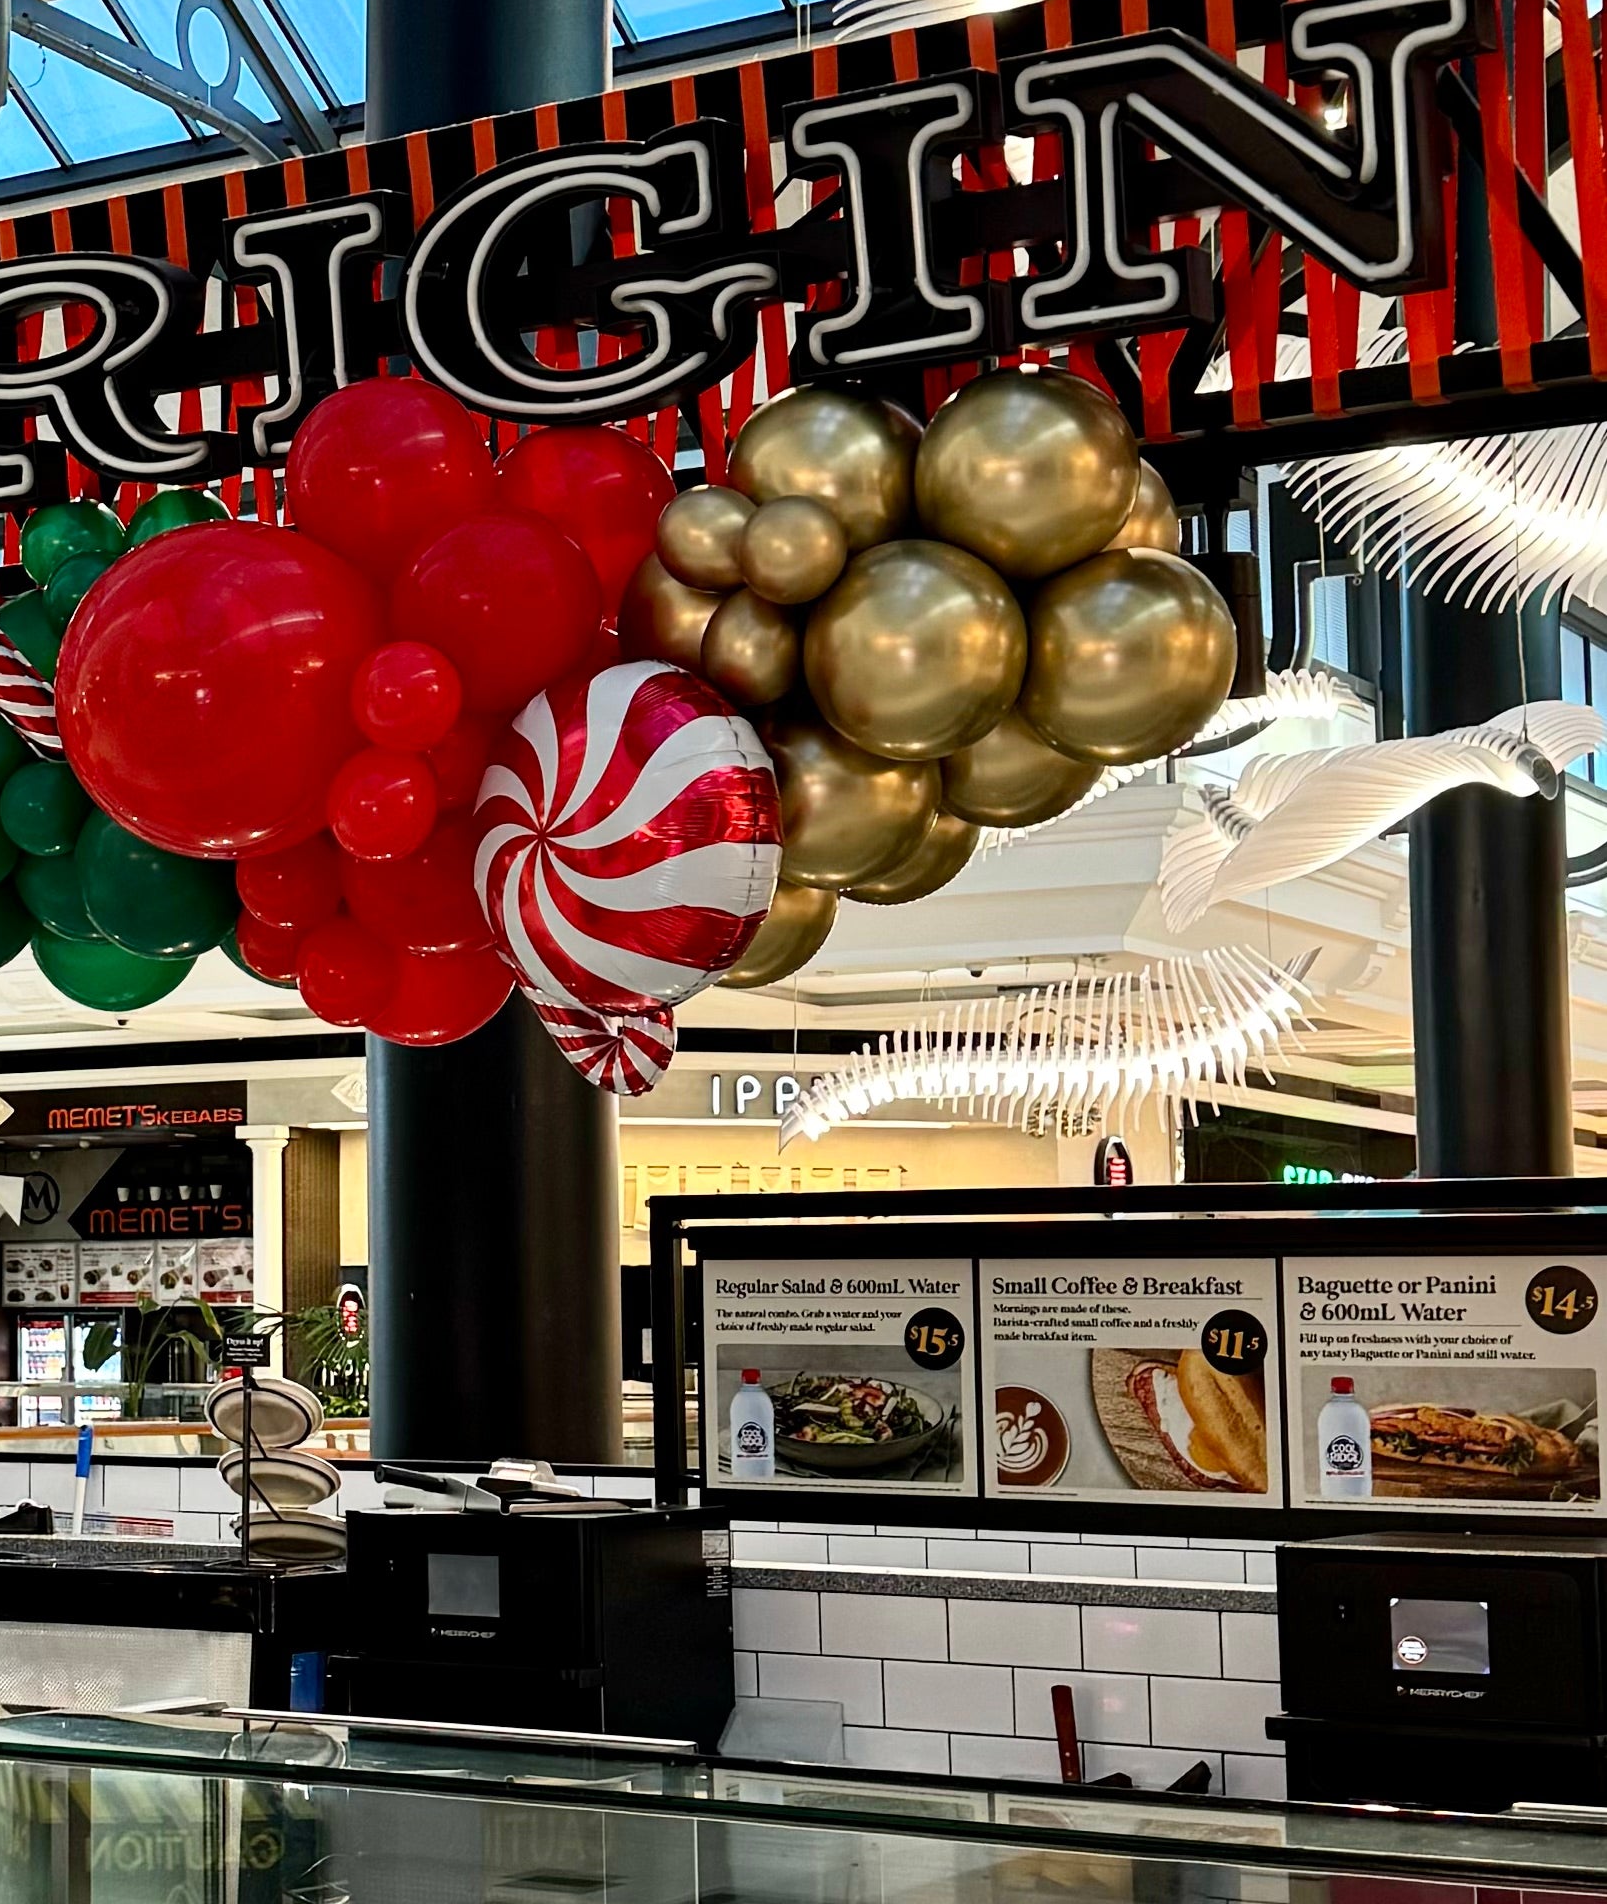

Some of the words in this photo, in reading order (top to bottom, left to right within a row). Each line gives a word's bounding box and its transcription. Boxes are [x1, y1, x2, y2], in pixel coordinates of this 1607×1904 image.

[712, 1074, 822, 1115] IPP
[48, 1104, 156, 1129] MEMET'S
[157, 1108, 243, 1125] KEBABS
[89, 1205, 242, 1234] MEMET'S
[715, 1278, 779, 1298] Regular
[782, 1278, 825, 1294] Salad
[830, 1279, 843, 1294] &
[847, 1279, 905, 1294] 600mL
[908, 1279, 961, 1294] Water
[992, 1277, 1047, 1295] Small
[1051, 1277, 1117, 1295] Coffee
[1122, 1277, 1138, 1295] &
[1143, 1277, 1243, 1295] Breakfast
[1298, 1276, 1393, 1300] Baguette
[1397, 1280, 1422, 1294] or
[1426, 1275, 1497, 1294] Panini
[993, 1304, 1040, 1315] Mornings
[1042, 1306, 1058, 1314] are
[1060, 1304, 1087, 1314] made
[1090, 1304, 1101, 1314] of
[1102, 1304, 1131, 1314] these.
[1299, 1303, 1316, 1321] &
[1321, 1303, 1395, 1321] 600mL
[1402, 1303, 1467, 1322] Water
[993, 1317, 1070, 1328] Barista-crafted
[1071, 1318, 1098, 1328] small
[1100, 1318, 1132, 1328] coffee
[1133, 1318, 1152, 1328] and
[1162, 1318, 1200, 1330] freshly
[994, 1332, 1020, 1342] made
[1022, 1331, 1069, 1342] breakfast
[1071, 1332, 1098, 1342] item.
[1319, 1336, 1334, 1347] up
[1336, 1336, 1349, 1344] on
[1351, 1333, 1403, 1345] freshness
[1405, 1334, 1431, 1344] with
[1433, 1336, 1459, 1347] your
[1461, 1334, 1499, 1345] choice
[1500, 1334, 1514, 1345] of
[1299, 1350, 1320, 1361] any
[1322, 1349, 1349, 1361] tasty
[1350, 1348, 1400, 1361] Baguette
[1402, 1351, 1414, 1359] or
[1416, 1348, 1451, 1359] Panini
[1453, 1349, 1474, 1359] and
[1476, 1349, 1498, 1360] still
[1499, 1350, 1536, 1360] water.
